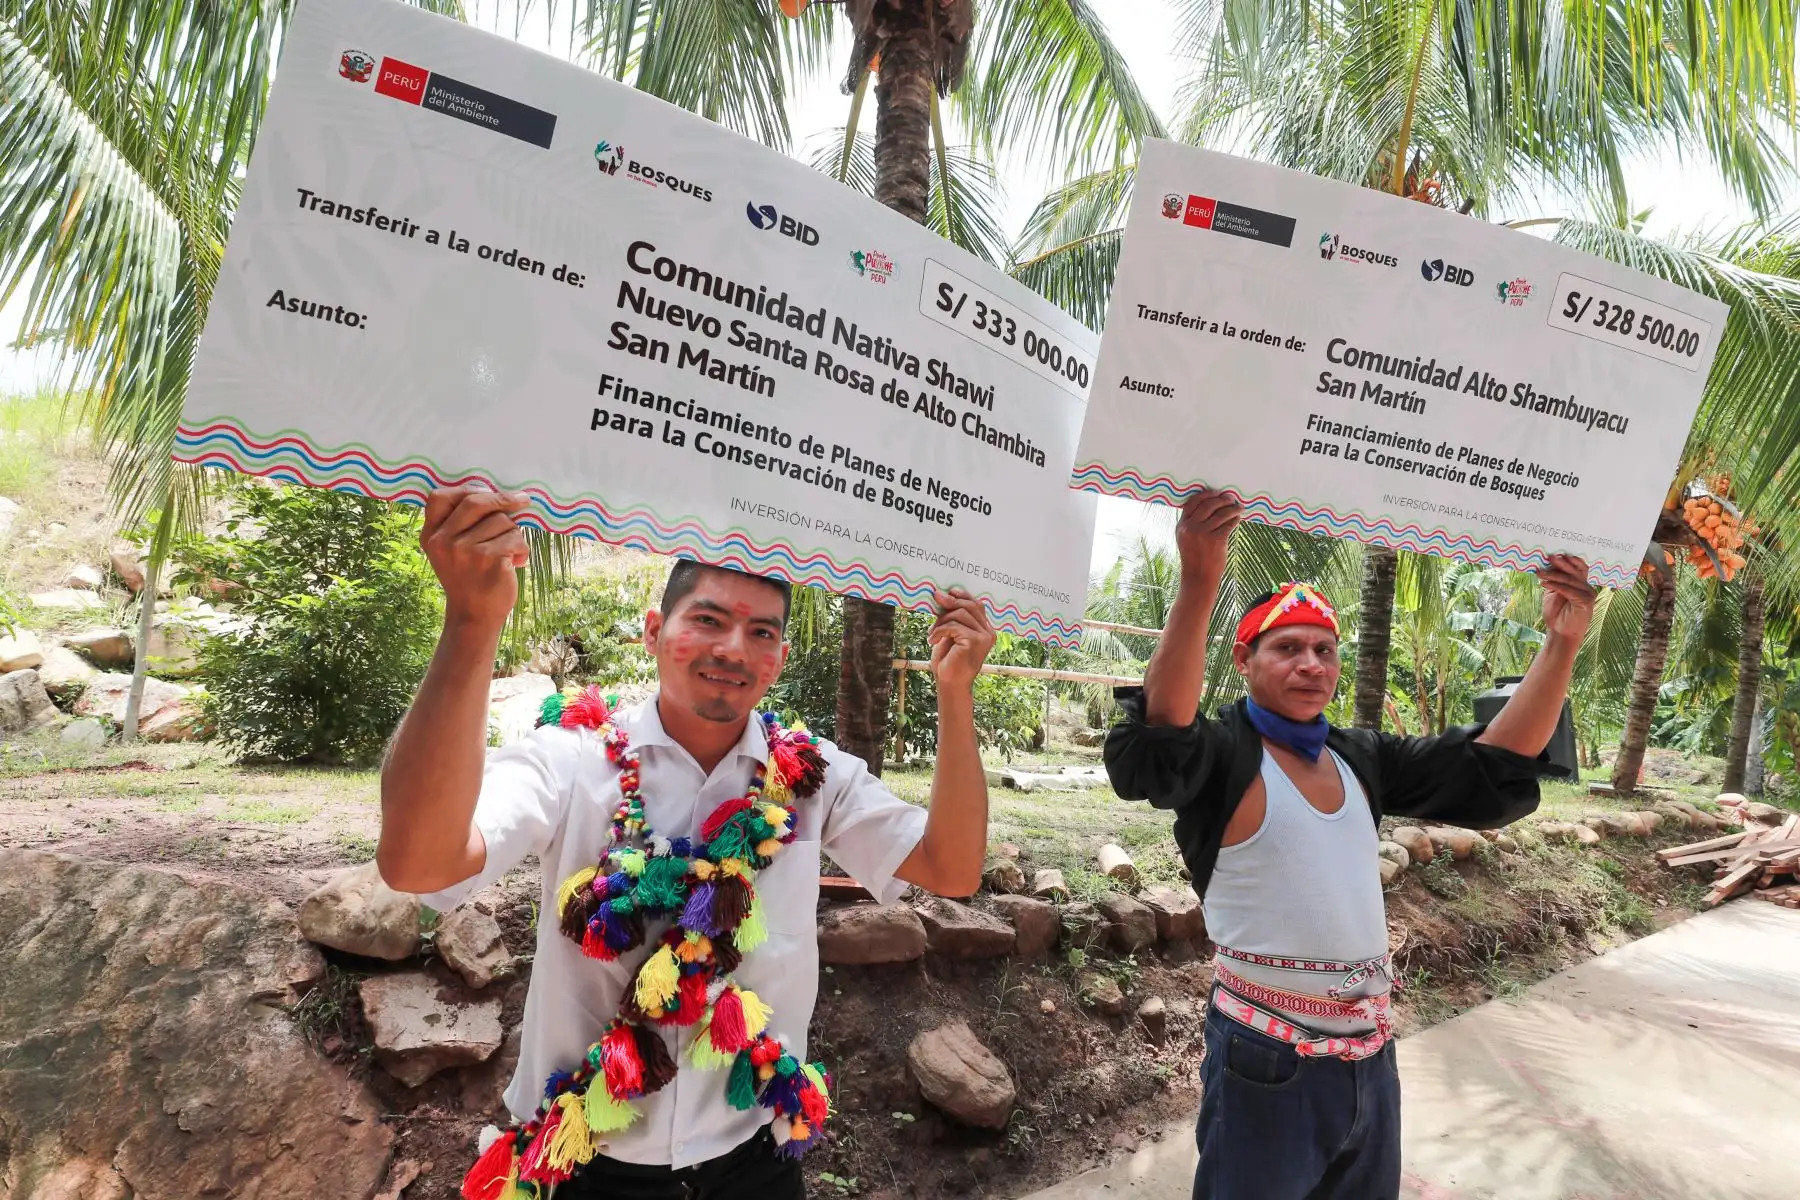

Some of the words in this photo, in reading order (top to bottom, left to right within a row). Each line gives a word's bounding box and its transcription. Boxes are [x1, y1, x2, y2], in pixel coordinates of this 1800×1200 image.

[384, 71, 420, 91] PERÚ
[431, 86, 485, 112] Ministerio
[428, 96, 446, 108] del
[448, 102, 500, 126] Ambiente
[628, 160, 712, 202] BOSQUES
[780, 215, 819, 246] BID
[1188, 206, 1210, 218] PERÚ
[1216, 212, 1250, 226] Ministerio
[1226, 221, 1259, 236] Ambiente
[298, 188, 420, 238] Transferir
[426, 230, 440, 244] a
[448, 230, 470, 253] la
[478, 246, 545, 276] orden
[552, 264, 585, 288] de:
[1340, 244, 1398, 267] BOSQUES
[1444, 265, 1474, 286] BID
[266, 290, 367, 329] Asunto:
[627, 241, 826, 338] Comunidad
[832, 317, 920, 378] Nativa
[926, 359, 994, 411] Shawi
[1138, 304, 1206, 330] Transferir
[1210, 323, 1218, 333] a
[1223, 322, 1236, 337] la
[1240, 329, 1281, 348] orden
[1285, 336, 1306, 352] de:
[1563, 292, 1593, 322] S/
[1593, 300, 1635, 335] 328
[1636, 315, 1699, 357] 500.00
[936, 282, 968, 318] S/
[972, 301, 1016, 345] 333
[1024, 330, 1088, 388] 000.00
[607, 322, 669, 364] San
[678, 342, 775, 398] Martín
[617, 281, 721, 338] Nuevo
[728, 320, 807, 370] Santa
[814, 350, 874, 395] Rosa
[881, 378, 909, 408] de
[913, 392, 956, 427] Alto
[962, 412, 1045, 468] Chambira
[1120, 376, 1174, 398] Asunto:
[1316, 372, 1356, 399] San
[1360, 380, 1426, 414] Martín
[1327, 338, 1463, 391] Comunidad
[1462, 372, 1507, 402] Alto
[1510, 383, 1628, 434] Shambuyacu
[598, 374, 792, 448] Financiamiento
[799, 435, 824, 459] de
[831, 444, 895, 482] Planes
[900, 469, 922, 491] de
[927, 478, 991, 515] Negocio
[1307, 414, 1431, 454] Financiamiento
[1436, 442, 1454, 459] de
[1457, 447, 1504, 470] Planes
[1508, 458, 1524, 475] de
[1527, 463, 1579, 488] Negocio
[591, 408, 653, 438] para
[662, 420, 685, 447] la
[694, 432, 846, 493] Conservación
[853, 479, 876, 502] de
[882, 488, 953, 526] Bosques
[1300, 439, 1339, 457] para
[1344, 443, 1359, 461] la
[1365, 449, 1466, 483] Conservación
[1470, 471, 1487, 488] de
[1490, 476, 1545, 500] Bosques
[1438, 505, 1462, 518] PARA
[1466, 510, 1478, 521] LA
[1548, 528, 1559, 537] DE
[1562, 530, 1596, 544] BOSQUES
[731, 497, 810, 528] INVERSIÓN
[815, 520, 850, 540] PARA
[856, 530, 871, 545] LA
[876, 537, 964, 570] CONSERVACIÓN
[967, 563, 980, 576] DE
[983, 568, 1026, 590] BOSQUES
[1028, 582, 1070, 604] PERUANOS
